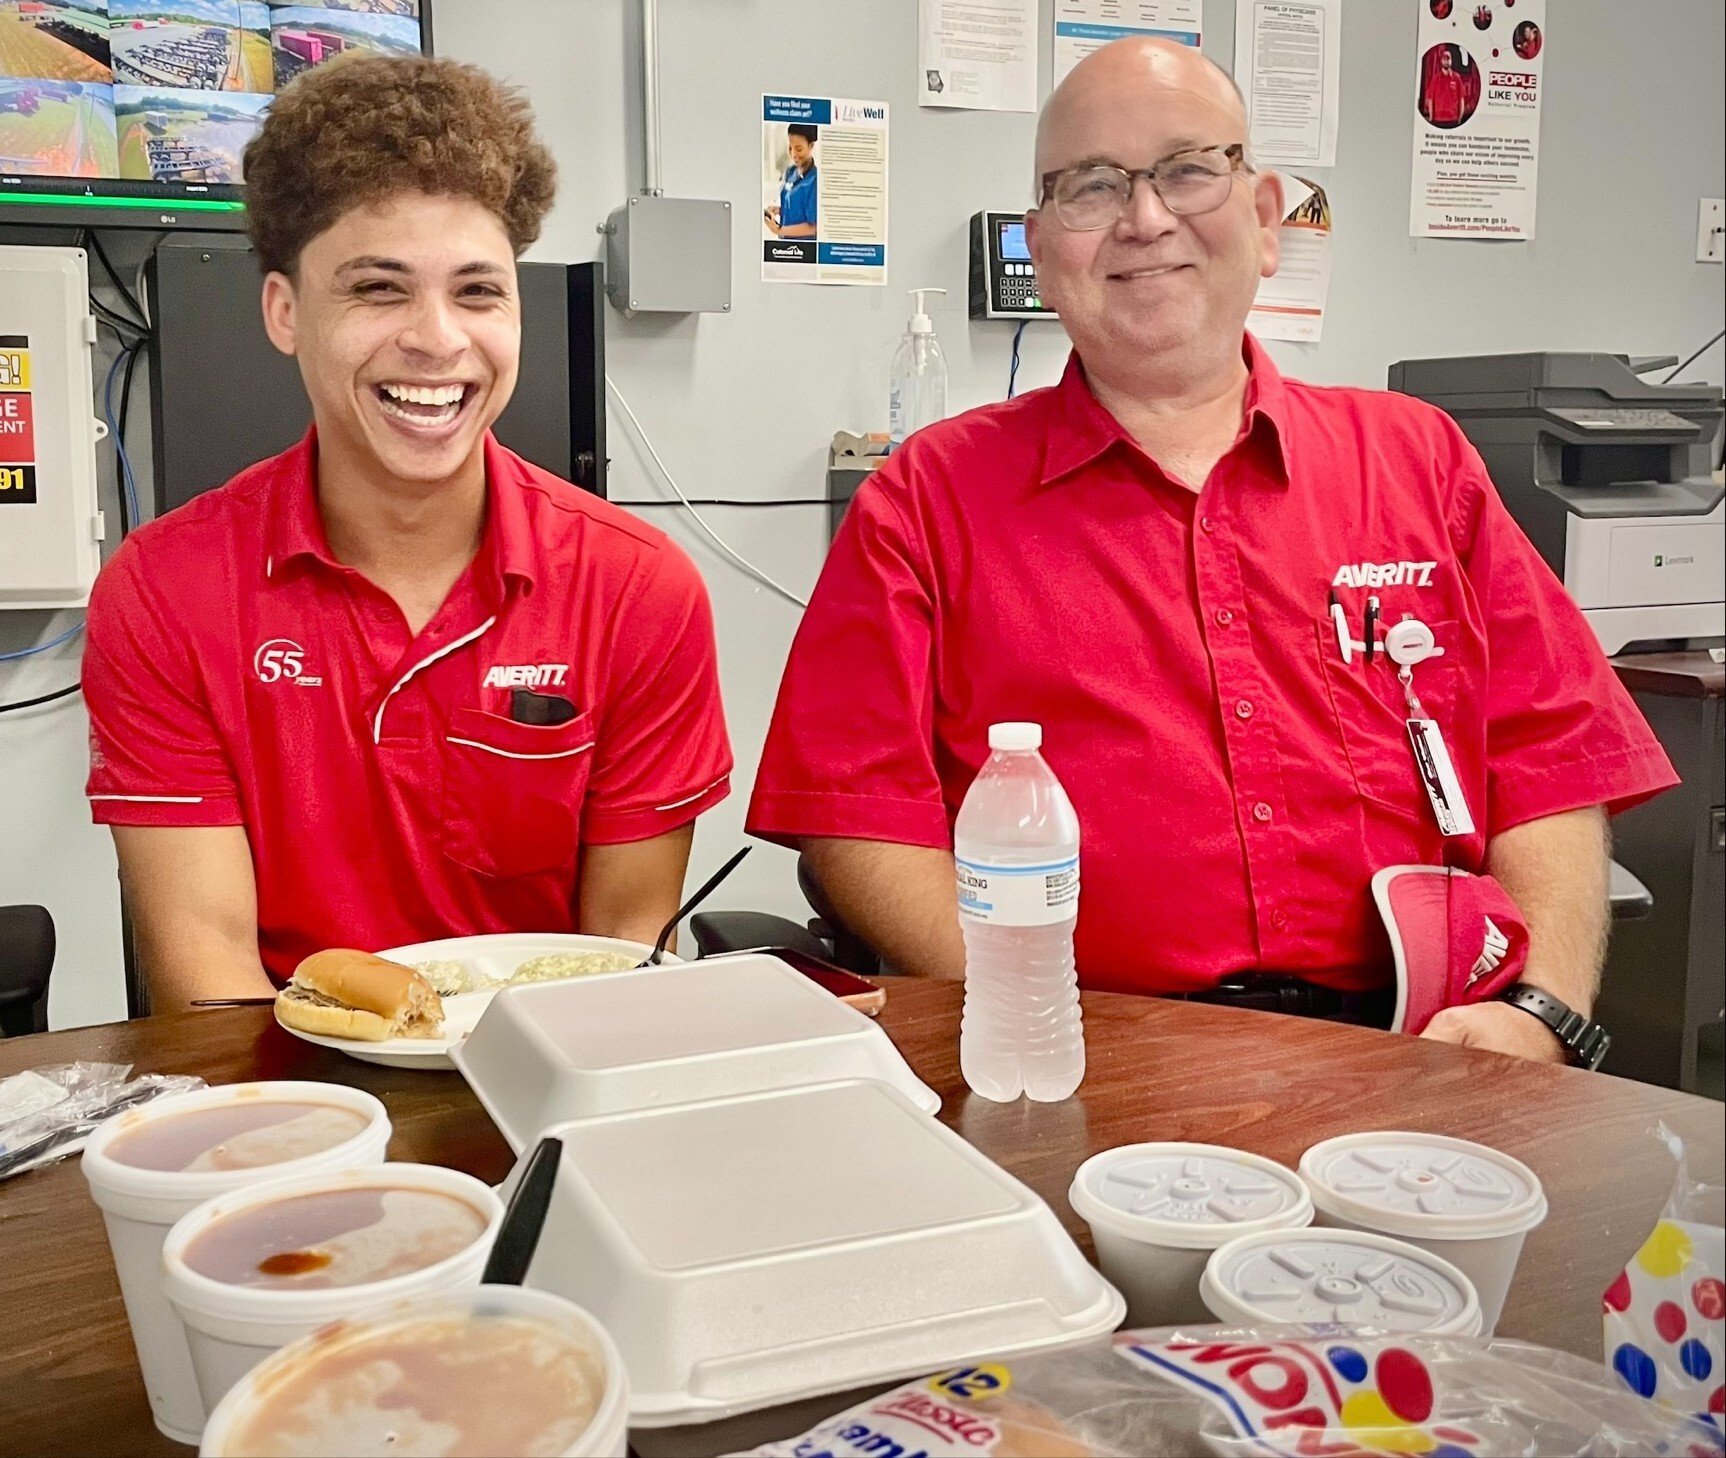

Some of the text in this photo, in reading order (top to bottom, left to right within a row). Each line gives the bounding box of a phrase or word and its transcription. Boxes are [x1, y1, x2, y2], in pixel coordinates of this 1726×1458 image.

[1490, 73, 1536, 87] PEOPLE
[1488, 90, 1536, 102] LIKE YOU
[1445, 214, 1453, 222] To
[0, 398, 18, 417] E
[1665, 556, 1694, 566] Lexmark
[260, 650, 305, 683] 55
[967, 876, 988, 889] KING
[938, 1367, 1000, 1397] 12
